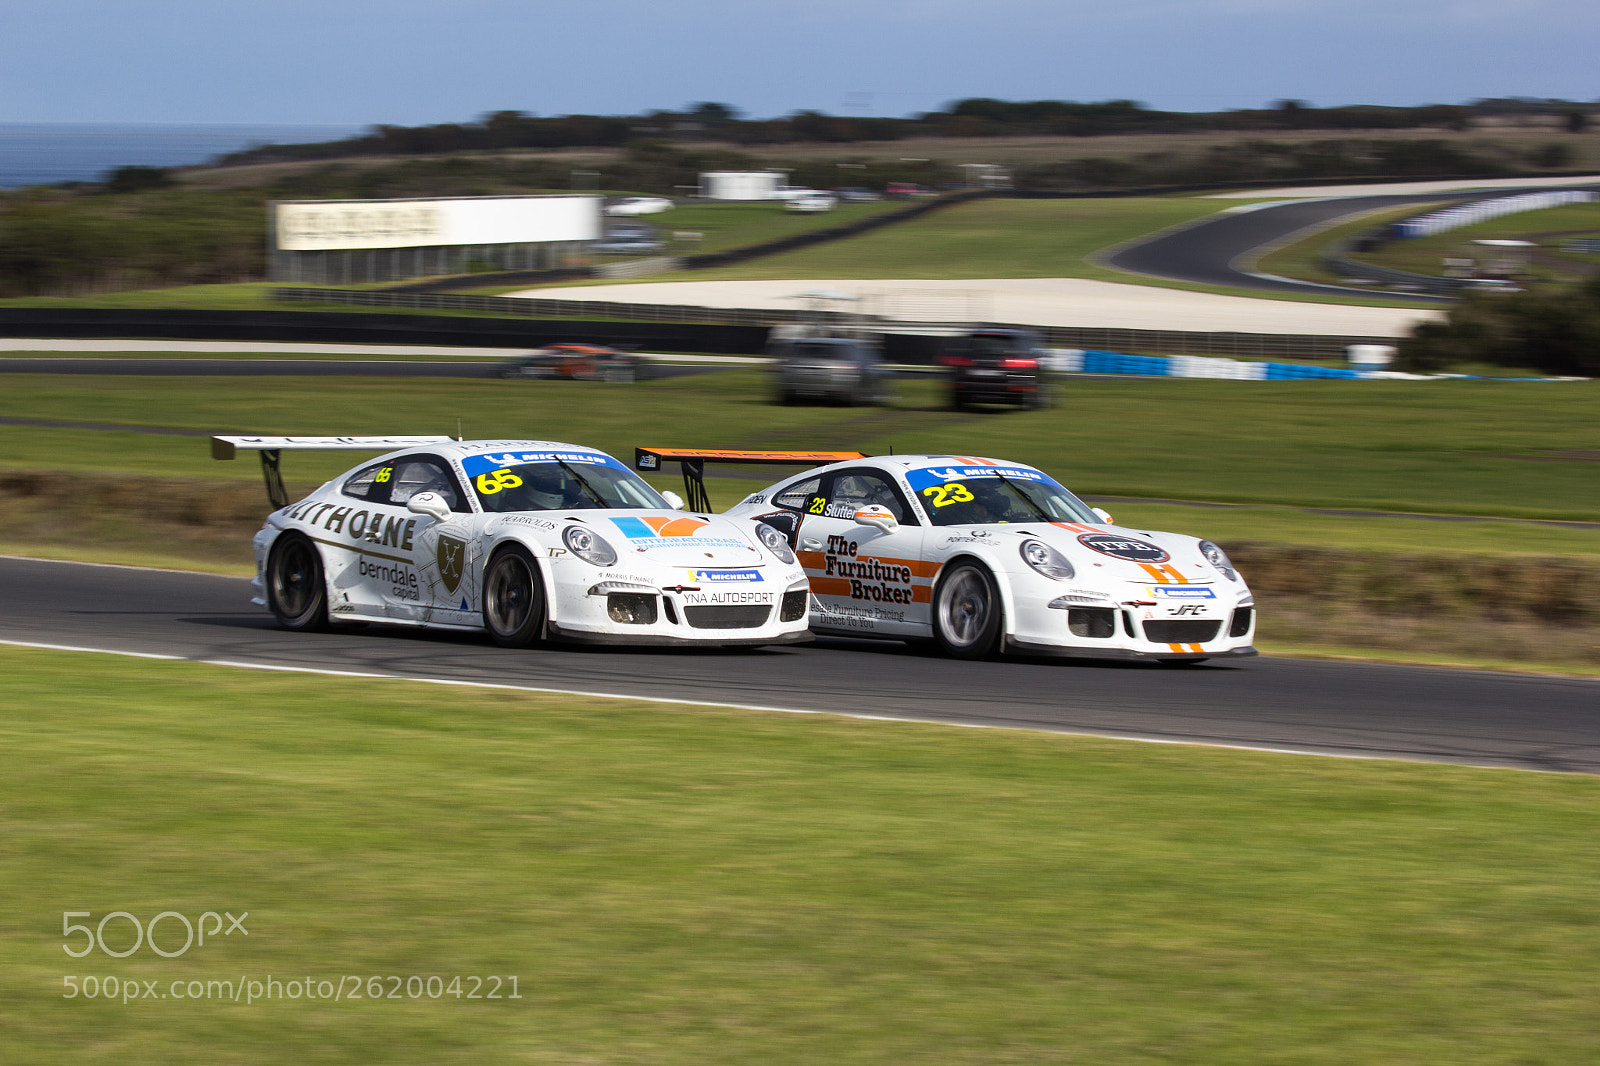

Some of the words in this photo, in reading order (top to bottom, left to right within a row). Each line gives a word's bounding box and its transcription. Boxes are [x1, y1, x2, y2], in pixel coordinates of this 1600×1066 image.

[521, 453, 607, 464] MICHELIN
[375, 467, 393, 483] 65
[476, 469, 523, 495] 65
[963, 469, 1042, 480] MICHELIN
[923, 483, 975, 508] 23
[809, 497, 826, 514] 23
[631, 537, 714, 545] INTEGRATED
[827, 534, 858, 557] The
[547, 547, 568, 557] TP
[359, 555, 418, 588] berndale
[825, 555, 911, 584] Furniture
[392, 584, 420, 601] capital
[683, 593, 708, 604] YNA
[710, 592, 775, 603] AUTOSPORT
[850, 579, 912, 605] Broker
[820, 613, 846, 626] Direct
[847, 616, 857, 627] To
[859, 617, 875, 628] You
[833, 603, 873, 618] Furniture
[874, 607, 905, 623] Pricing
